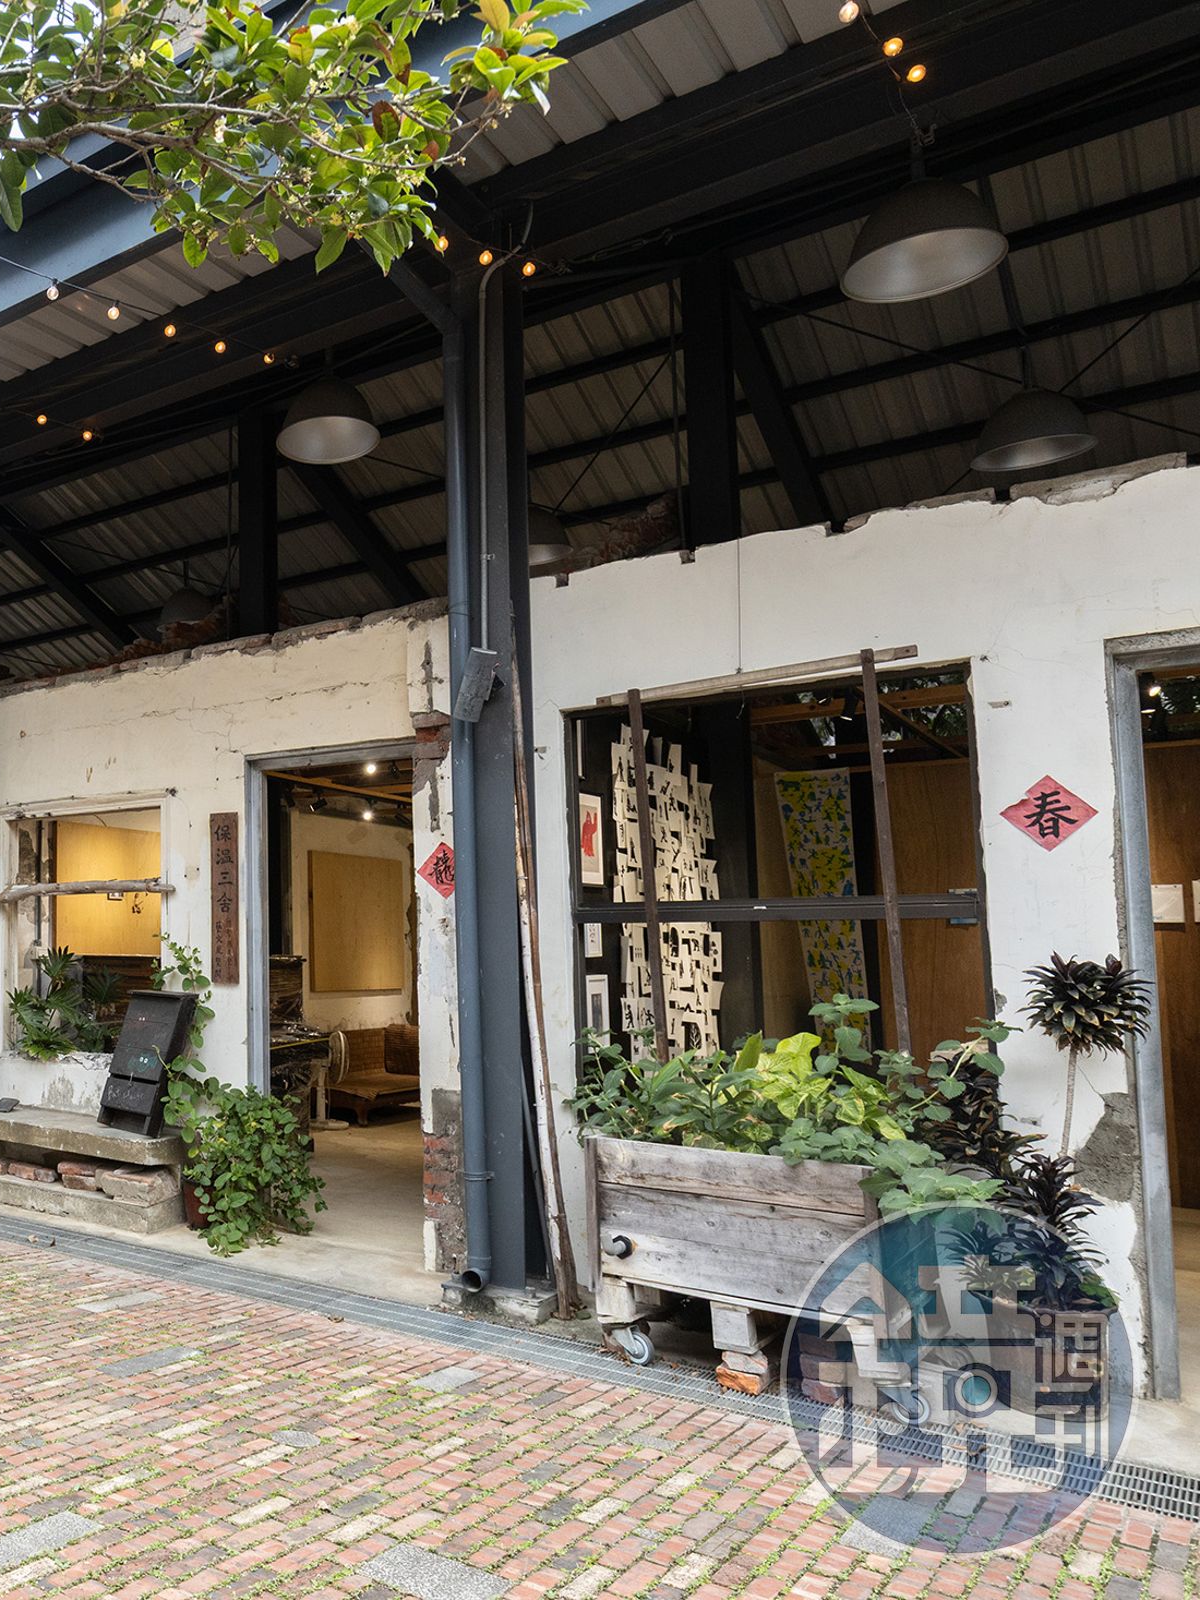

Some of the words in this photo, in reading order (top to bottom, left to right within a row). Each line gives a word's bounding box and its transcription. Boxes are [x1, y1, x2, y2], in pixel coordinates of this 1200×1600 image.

[1023, 790, 1080, 839] 春
[214, 825, 234, 914] 保溫三舍
